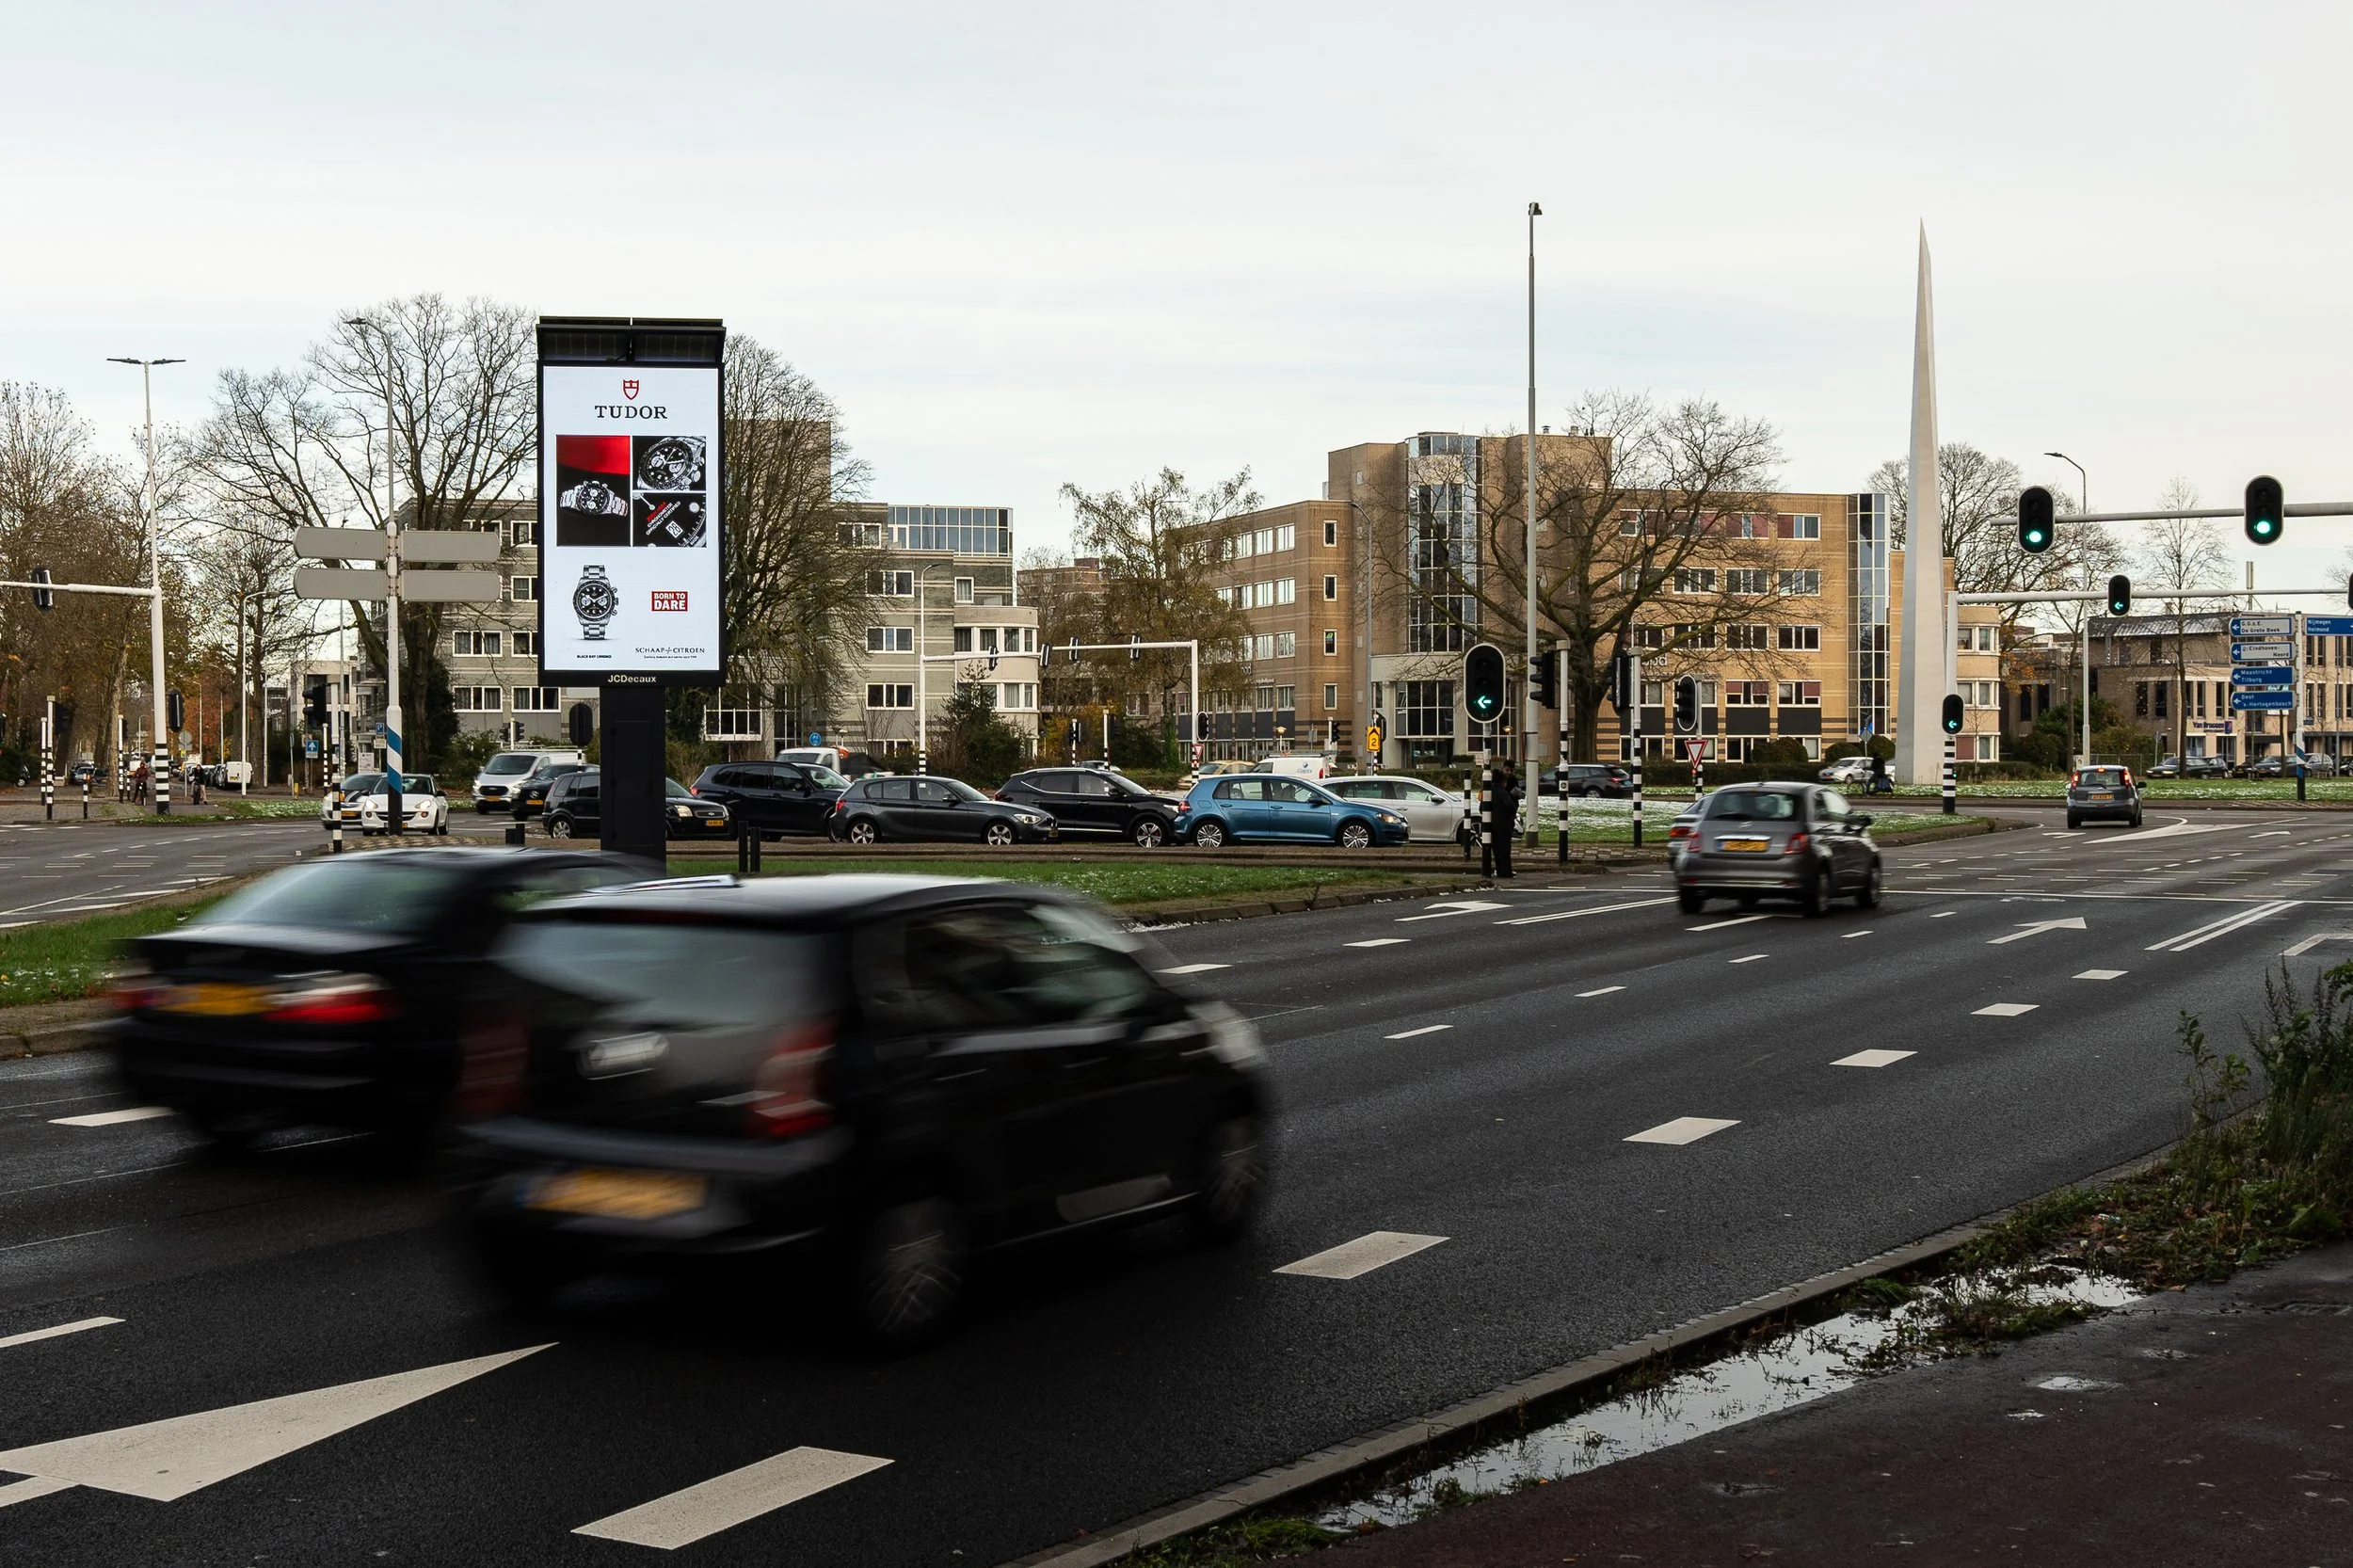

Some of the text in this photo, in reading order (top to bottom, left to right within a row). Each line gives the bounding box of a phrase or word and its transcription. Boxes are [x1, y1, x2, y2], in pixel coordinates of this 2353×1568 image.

[594, 405, 668, 420] TUDOR
[668, 522, 681, 536] 28
[653, 600, 686, 611] DARE
[607, 674, 657, 683] JCDecaux
[1371, 737, 1377, 746] 2
